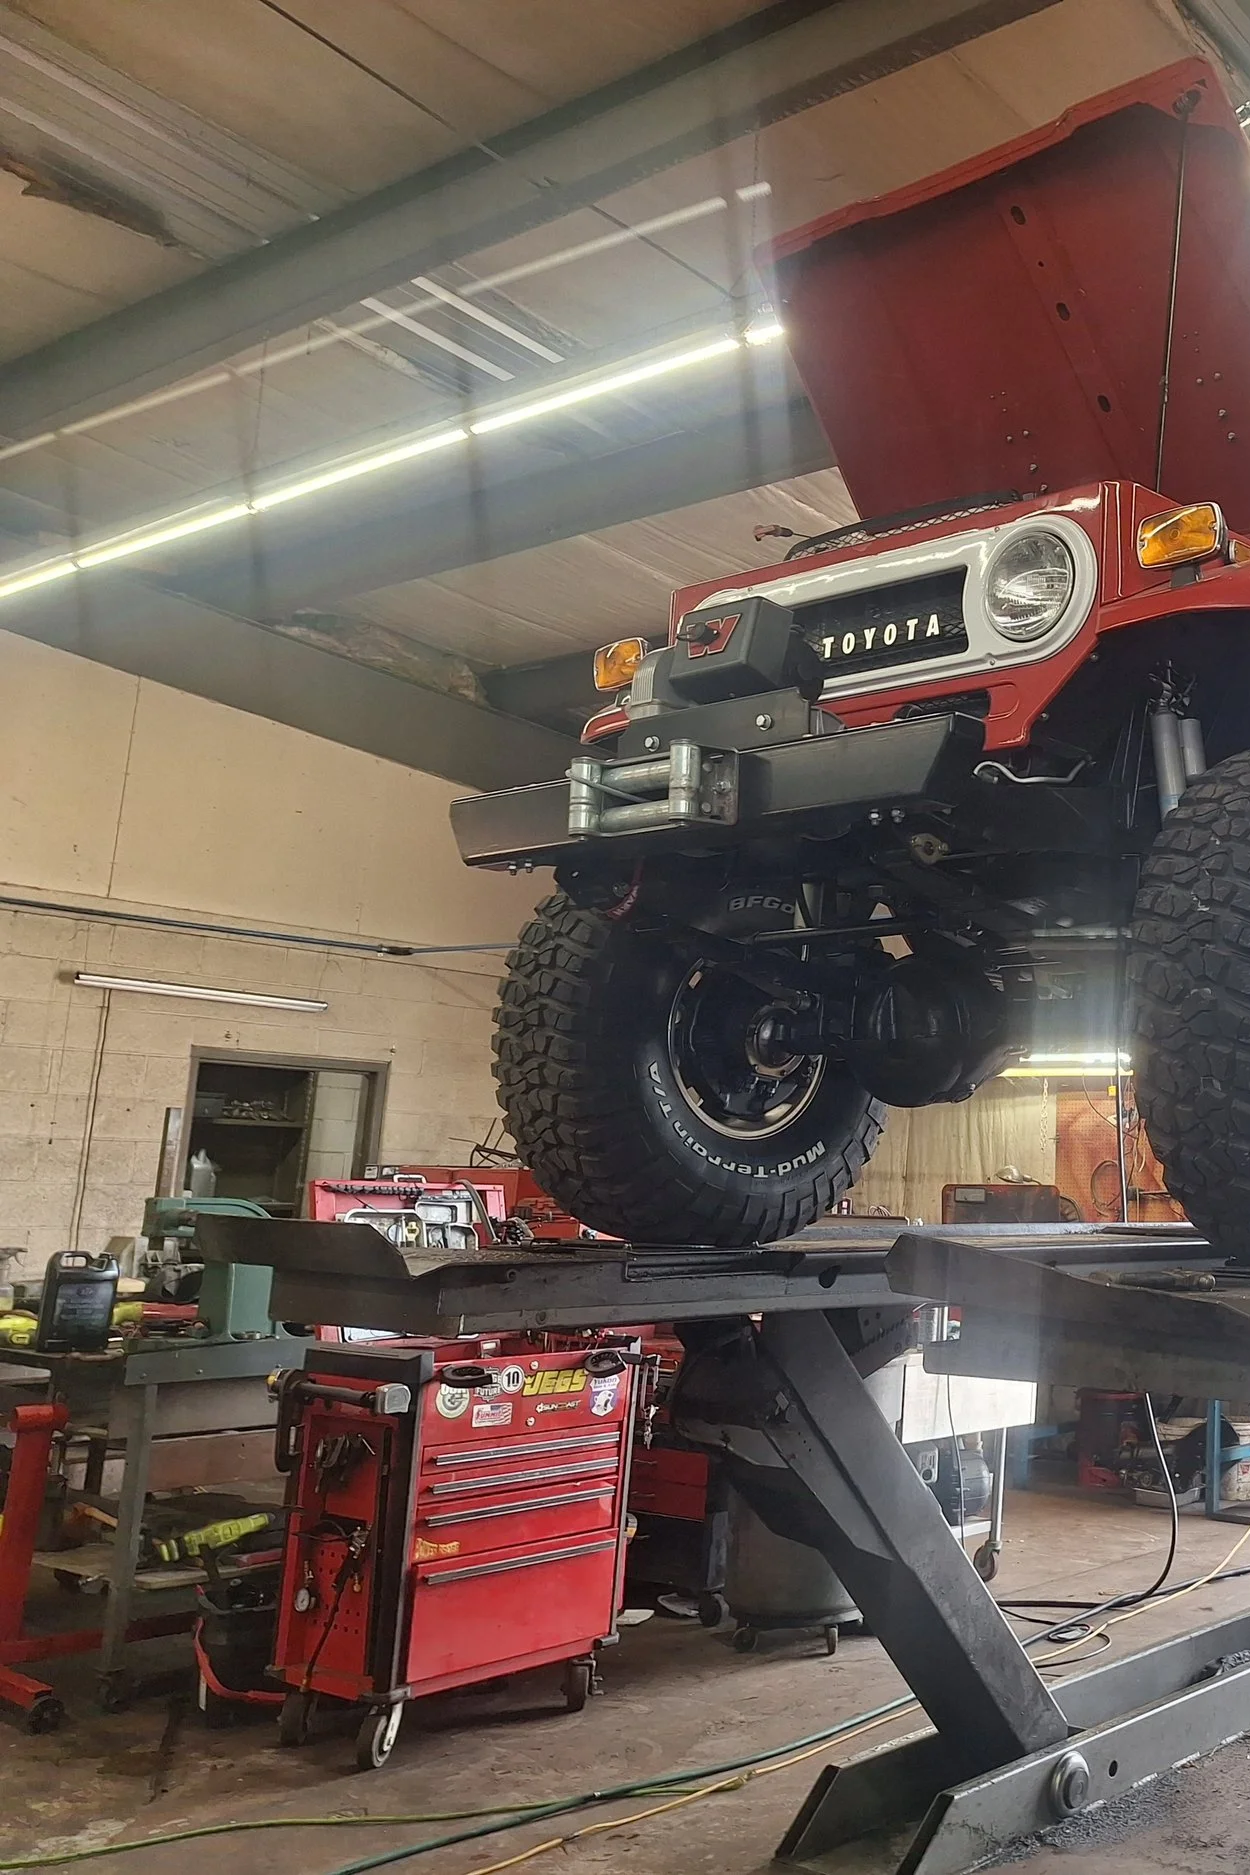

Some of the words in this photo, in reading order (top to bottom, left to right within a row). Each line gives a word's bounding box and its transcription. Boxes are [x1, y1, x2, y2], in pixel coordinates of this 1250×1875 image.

[822, 613, 941, 659] TOYOTA
[648, 1060, 674, 1120] T/A
[672, 1120, 827, 1179] Mud-Terrain
[505, 1370, 520, 1388] 10
[523, 1368, 587, 1397] JEGS
